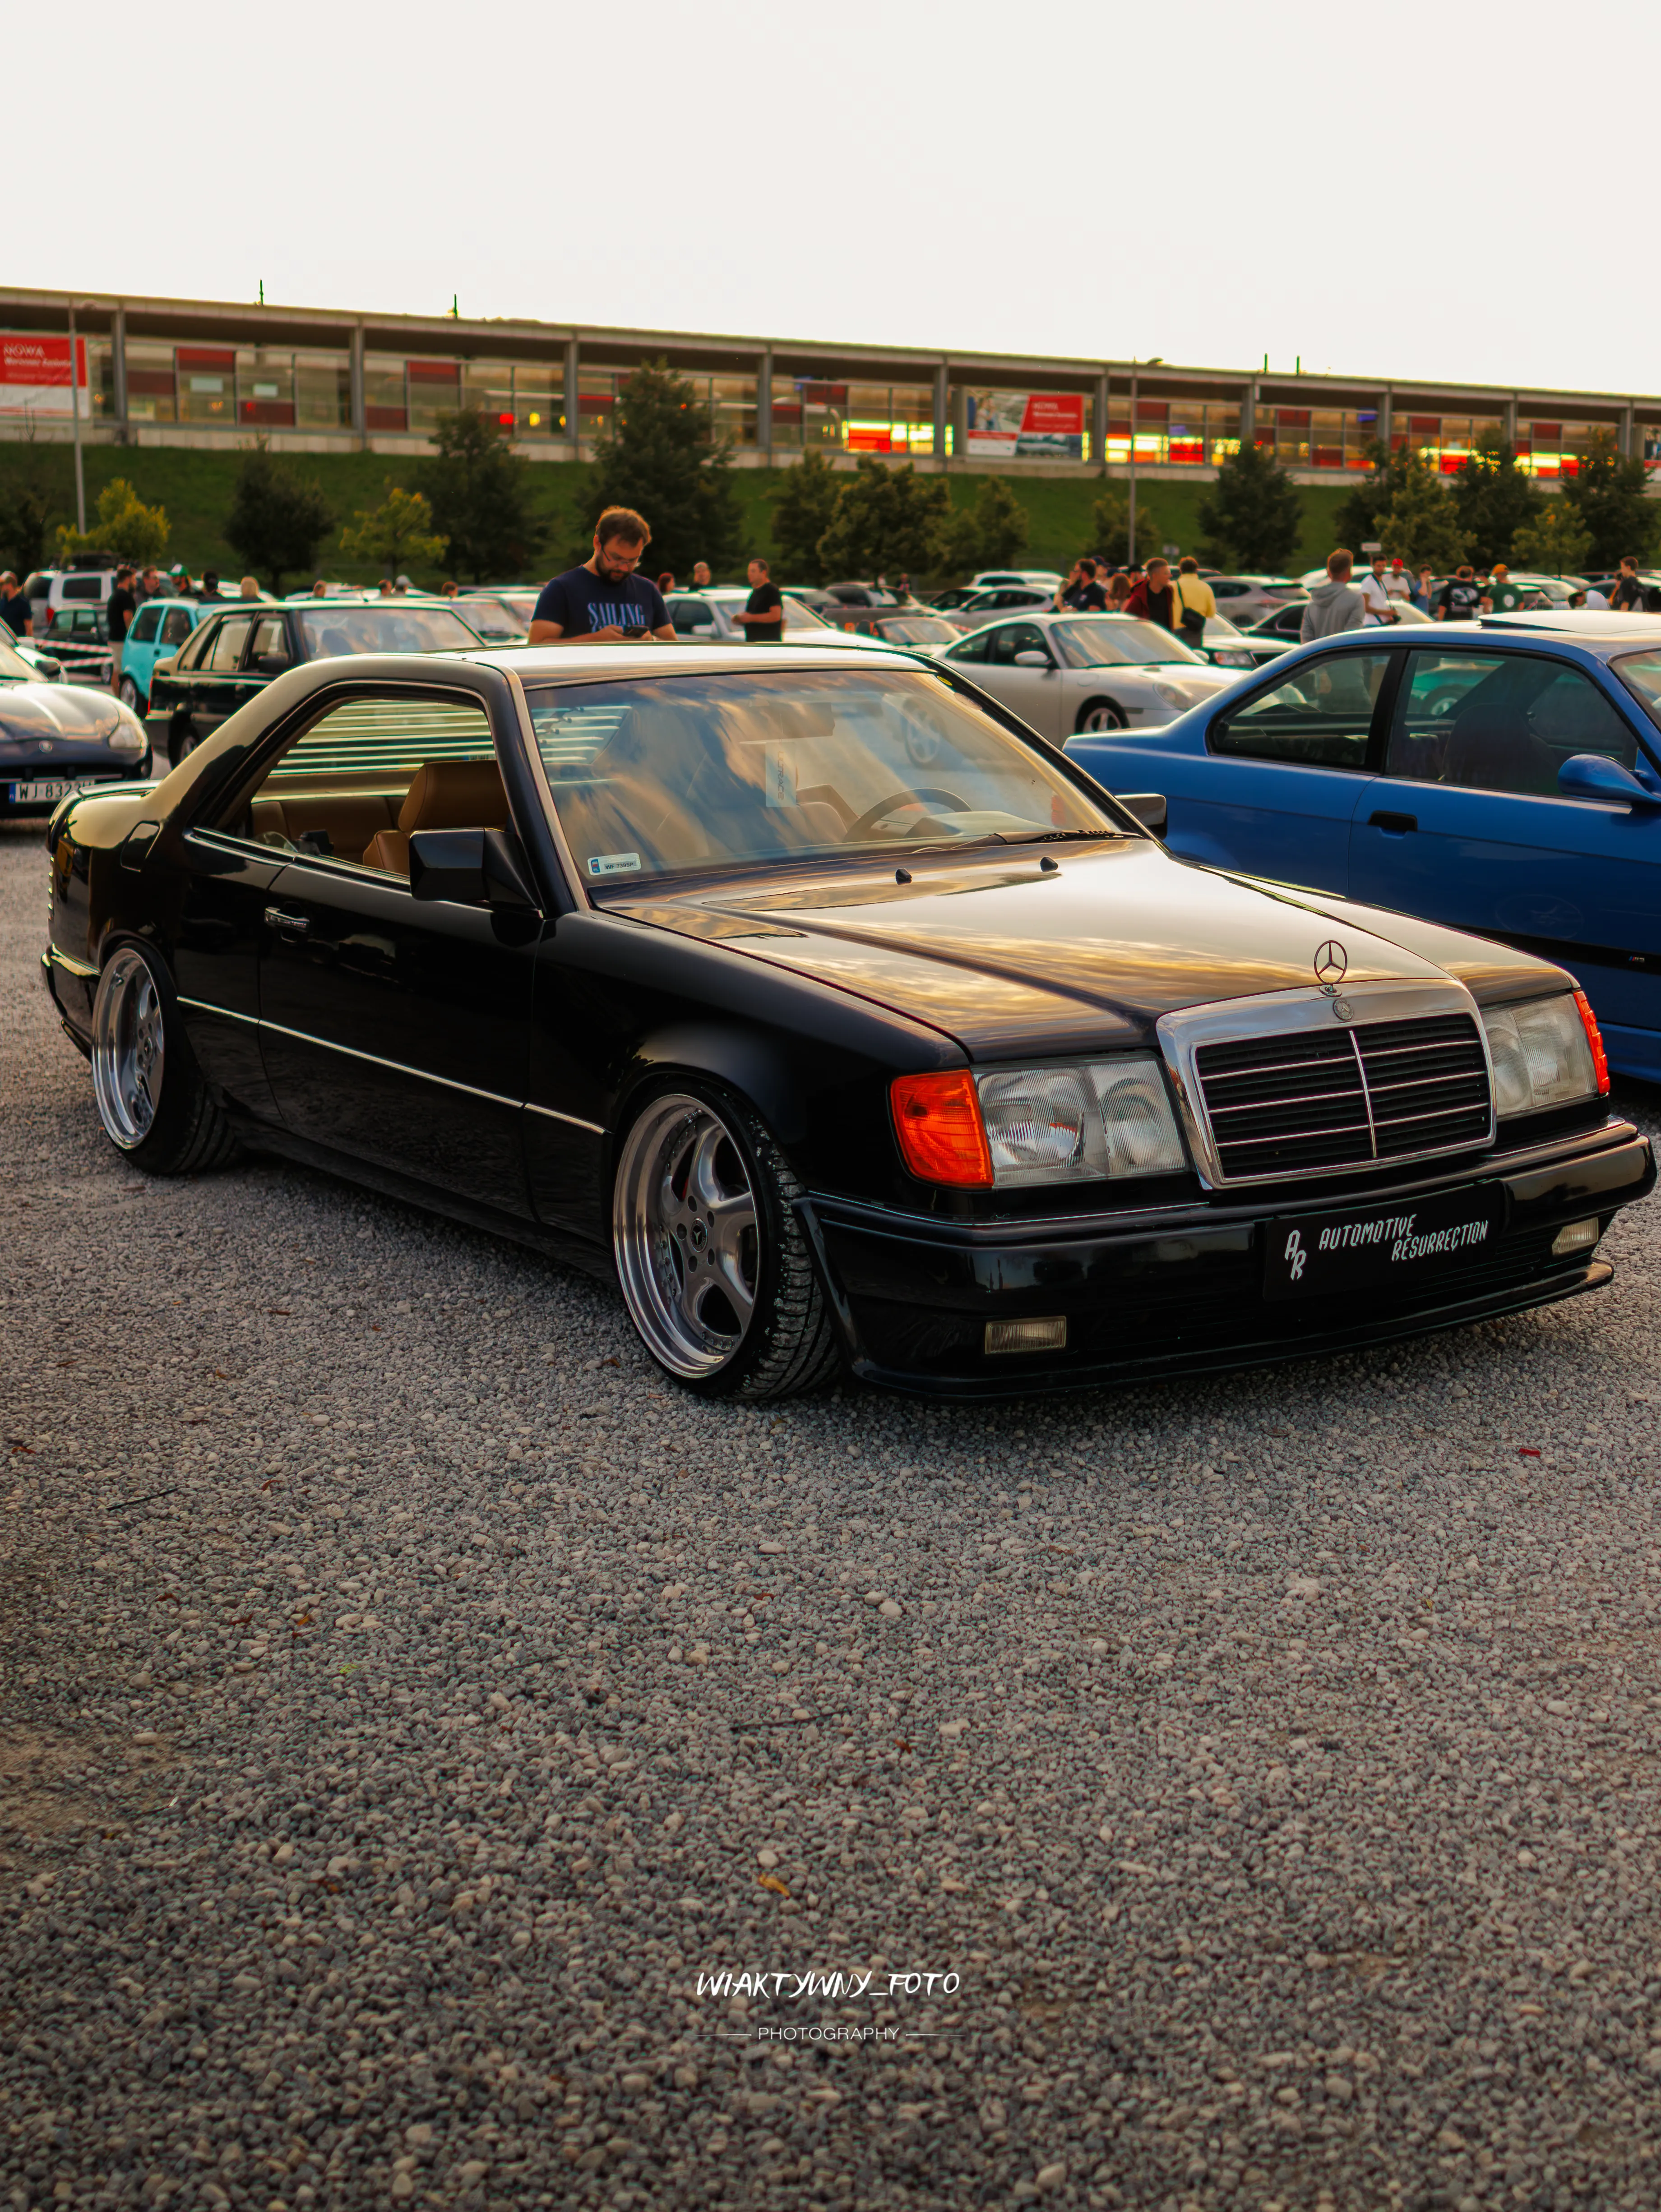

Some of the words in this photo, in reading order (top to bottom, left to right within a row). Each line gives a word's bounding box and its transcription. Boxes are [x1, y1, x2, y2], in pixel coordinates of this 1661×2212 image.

[588, 603, 645, 626] SAILING
[19, 784, 38, 800] WJ
[1319, 1214, 1417, 1250] AUTOMOTIVE
[1391, 1219, 1489, 1262] RESURRECTION
